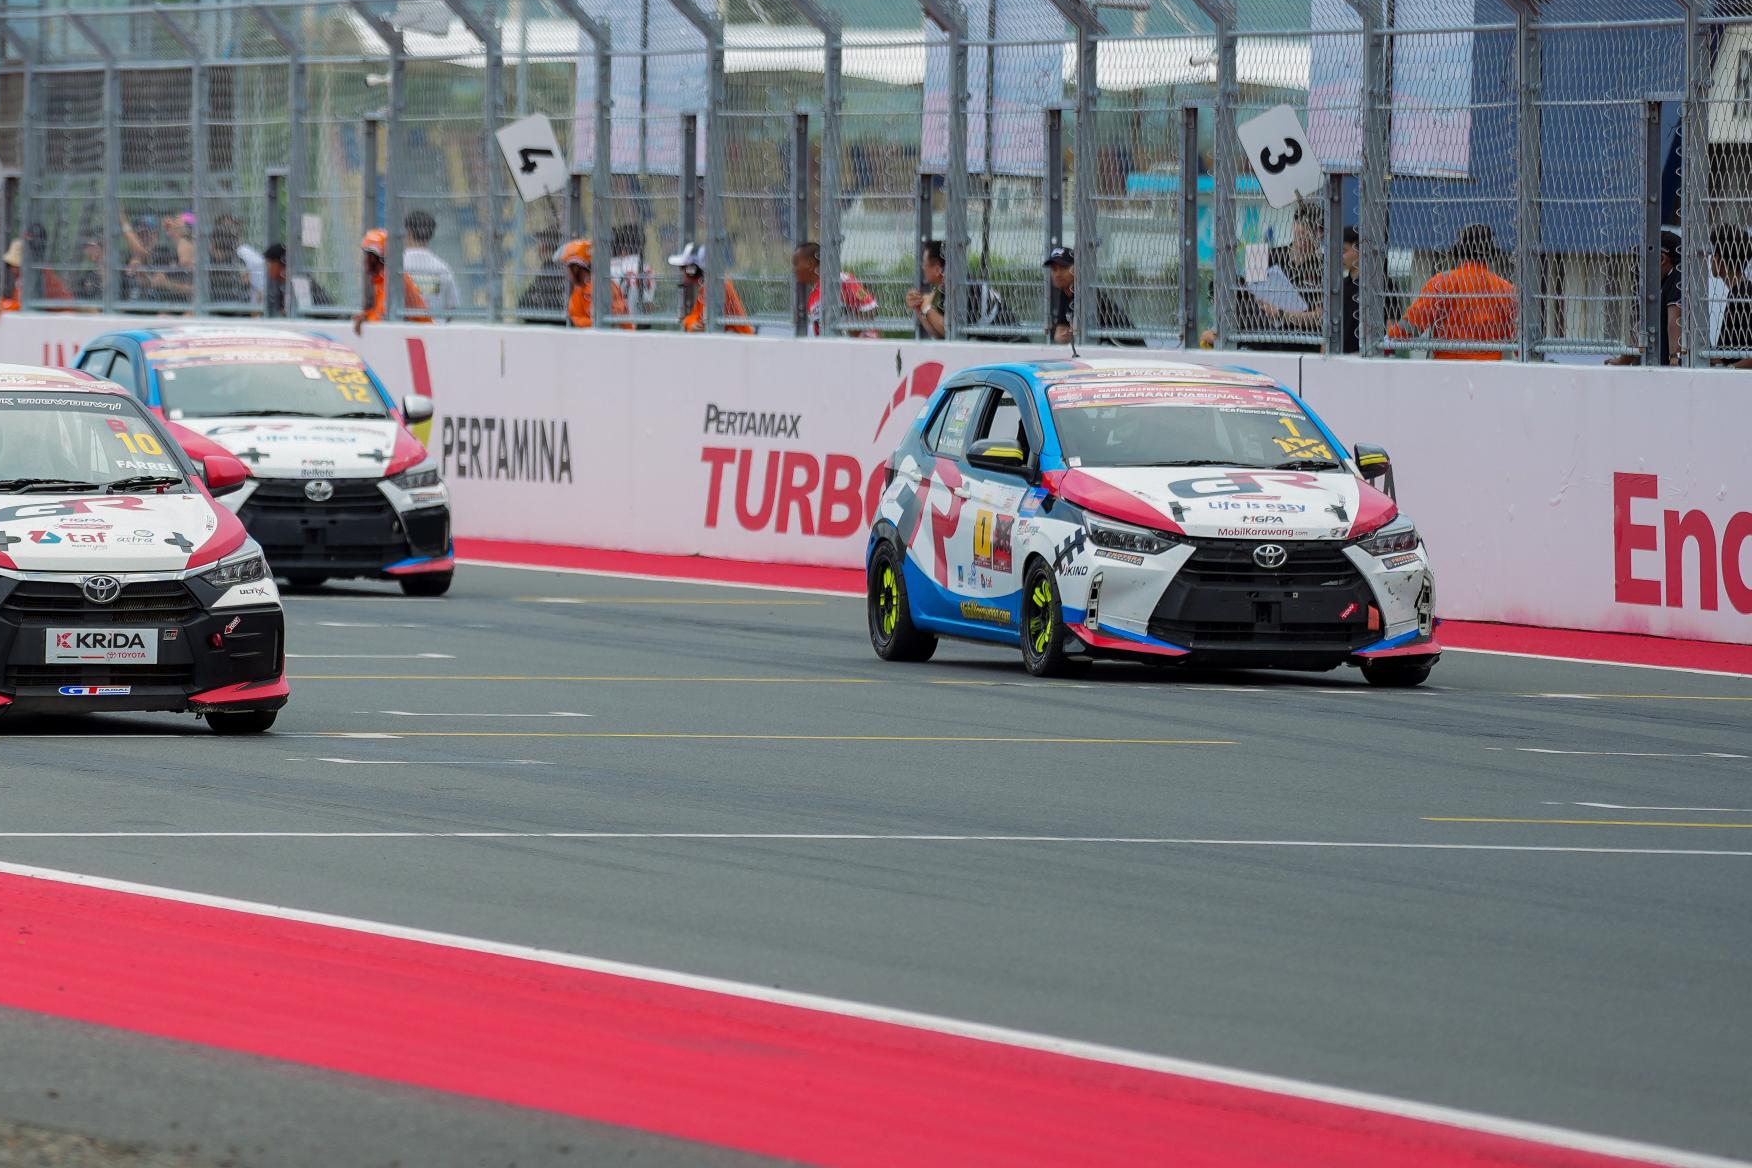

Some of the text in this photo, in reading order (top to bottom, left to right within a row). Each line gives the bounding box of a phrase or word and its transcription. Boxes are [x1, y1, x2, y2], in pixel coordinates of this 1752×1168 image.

[1259, 137, 1303, 175] 3
[1093, 392, 1174, 400] KEJUARAAN
[1177, 392, 1243, 401] NASIONAL
[703, 403, 803, 439] PERTAMAX
[1278, 418, 1301, 437] 1
[114, 432, 164, 456] 10
[440, 415, 573, 485] PERTAMINA
[115, 460, 179, 472] FARREL
[1167, 472, 1327, 499] GR
[1208, 501, 1306, 513] Life is easy
[1242, 515, 1285, 524] MGPA
[66, 531, 108, 543] taf
[1217, 527, 1308, 538] MobilKarawang.com
